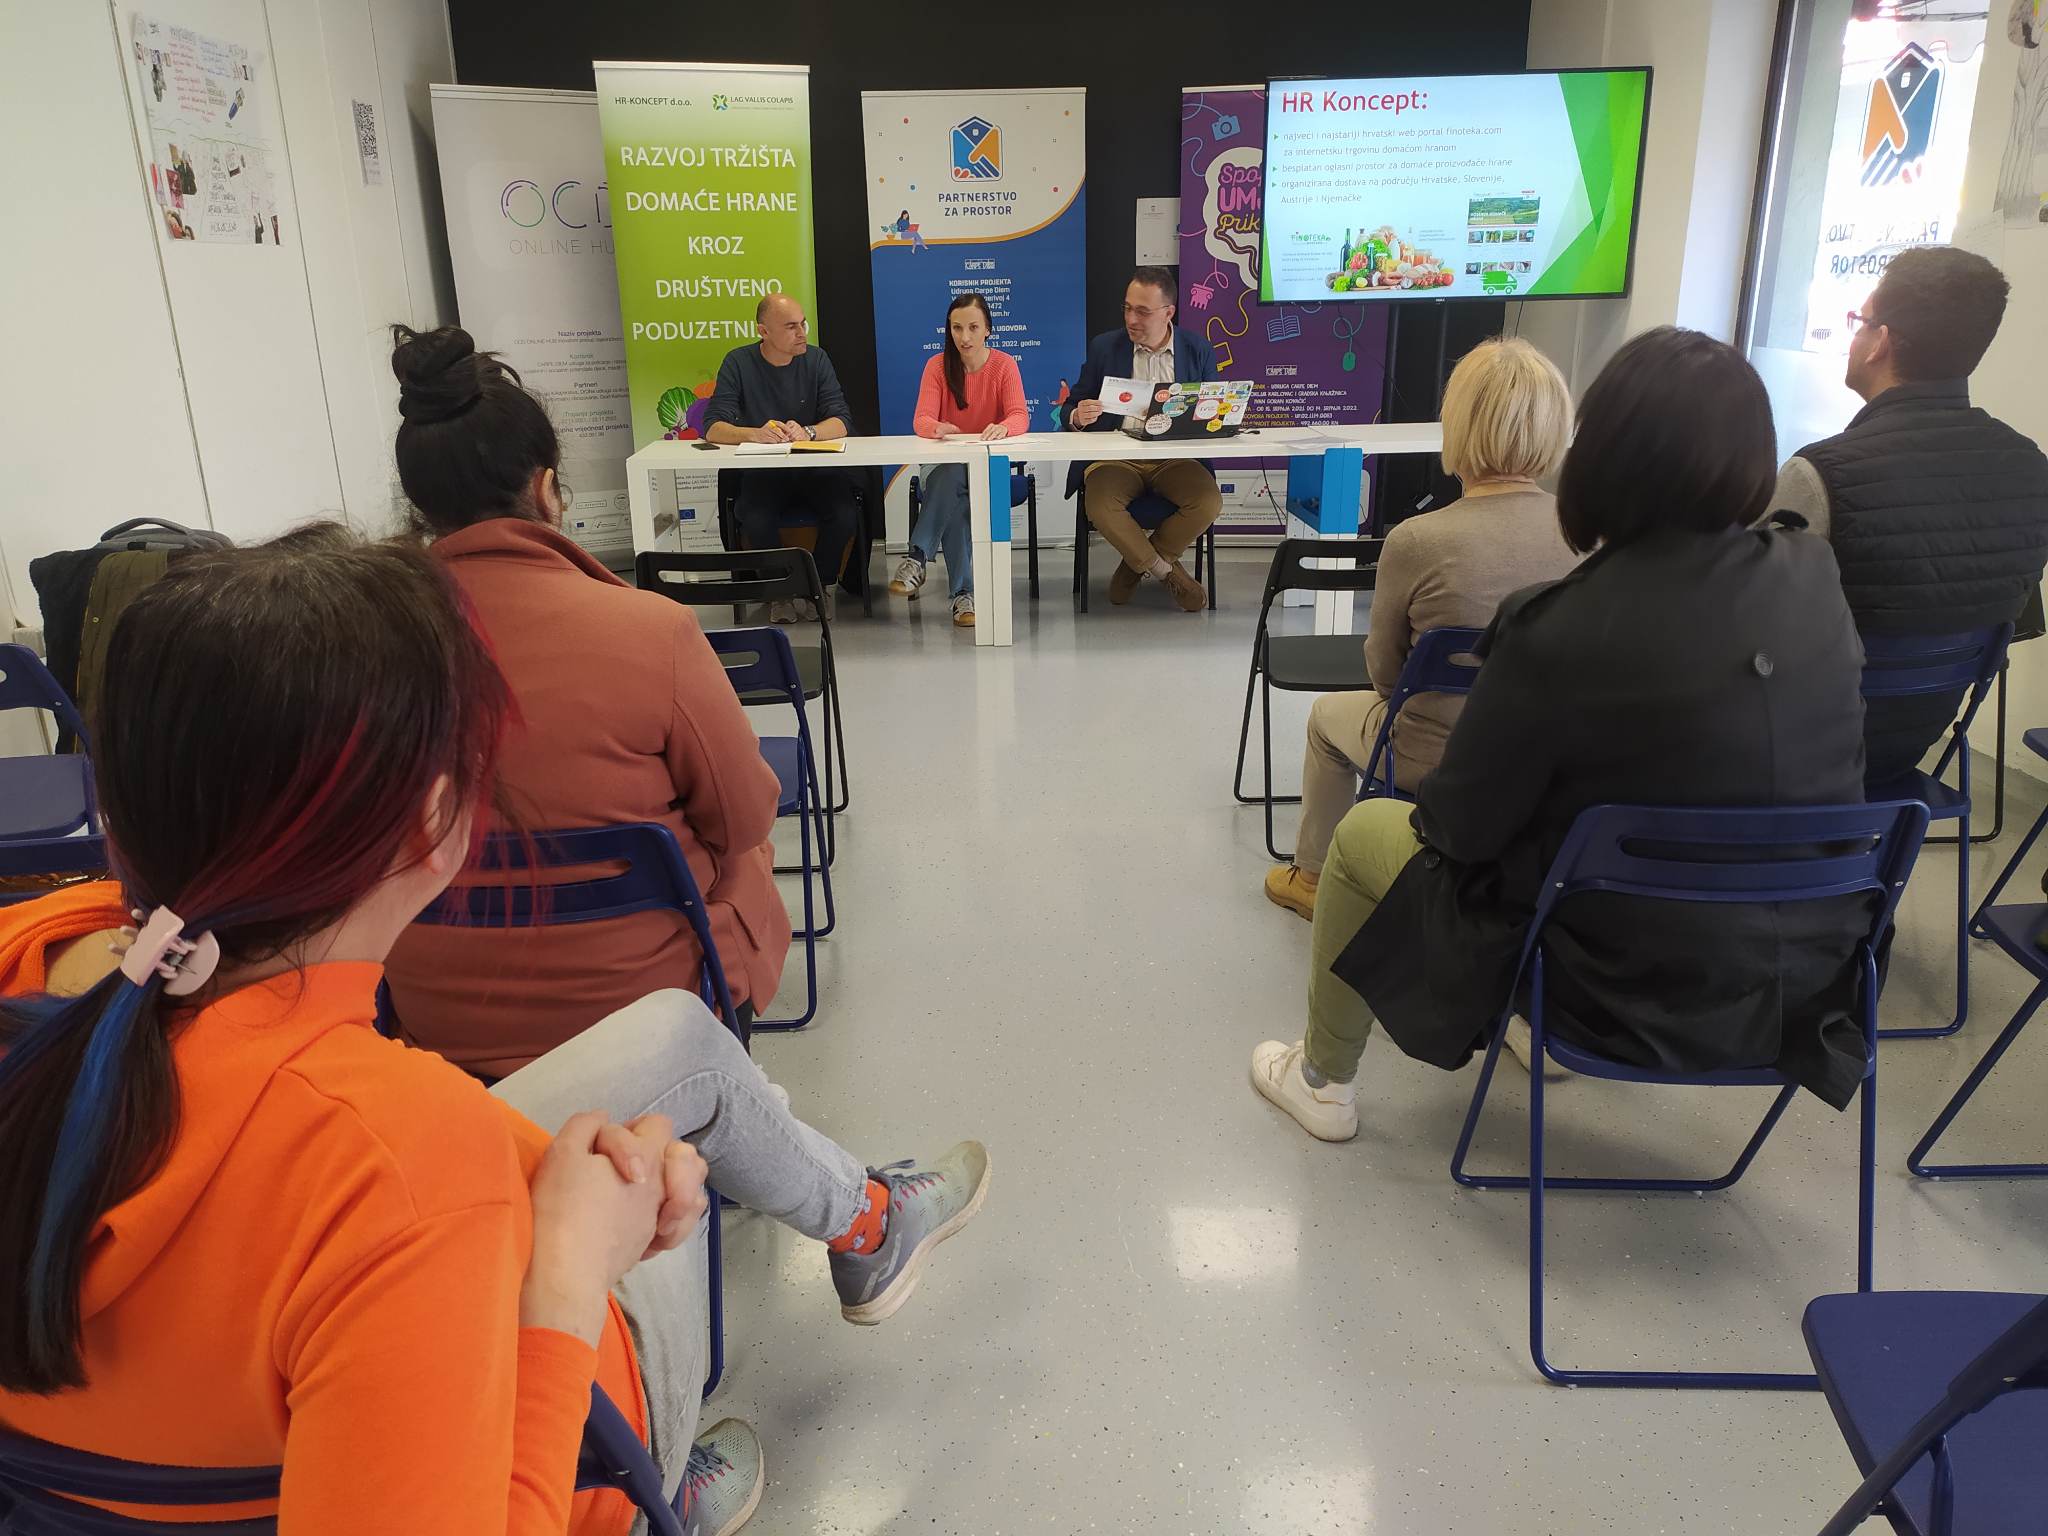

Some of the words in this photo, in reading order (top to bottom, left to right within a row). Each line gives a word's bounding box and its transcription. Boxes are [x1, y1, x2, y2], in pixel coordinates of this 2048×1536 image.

[614, 96, 668, 106] HR-KONCEPT
[670, 97, 692, 106] d.o.o.
[745, 96, 766, 104] VALLIS
[766, 96, 794, 104] COLAPIS
[1282, 92, 1314, 113] HR
[1322, 90, 1428, 115] Koncept:
[1362, 129, 1395, 138] hrvatski
[1398, 128, 1416, 137] web
[1417, 127, 1443, 139] portal
[1446, 126, 1502, 136] finoteka.com
[620, 146, 705, 168] RAZVOJ
[710, 143, 797, 168] TRŽIŠTA
[1283, 149, 1293, 157] za
[1295, 147, 1343, 156] internetsku
[1345, 146, 1379, 157] trgovinu
[1424, 143, 1457, 152] hranom
[1282, 163, 1322, 173] besplatan
[1324, 163, 1353, 173] oglasni
[1355, 162, 1385, 172] prostor
[1487, 158, 1513, 167] hrane
[1281, 180, 1332, 189] organizirana
[1334, 179, 1367, 187] dostava
[625, 188, 720, 211] DOMAĆE
[726, 192, 798, 212] HRANE
[938, 191, 1017, 203] PARTNERSTVO
[1281, 194, 1314, 205] Austrije
[944, 206, 958, 217] ZA
[963, 205, 1012, 217] PROSTOR
[509, 239, 582, 255] ONLINE
[688, 236, 745, 255] KROZ
[655, 275, 783, 298] DRUŠTVENO
[949, 279, 979, 287] KORISNIK
[980, 278, 1011, 286] PROJEKTA
[975, 287, 993, 295] Carpe
[994, 286, 1010, 294] Diem
[1020, 340, 1041, 348] godine
